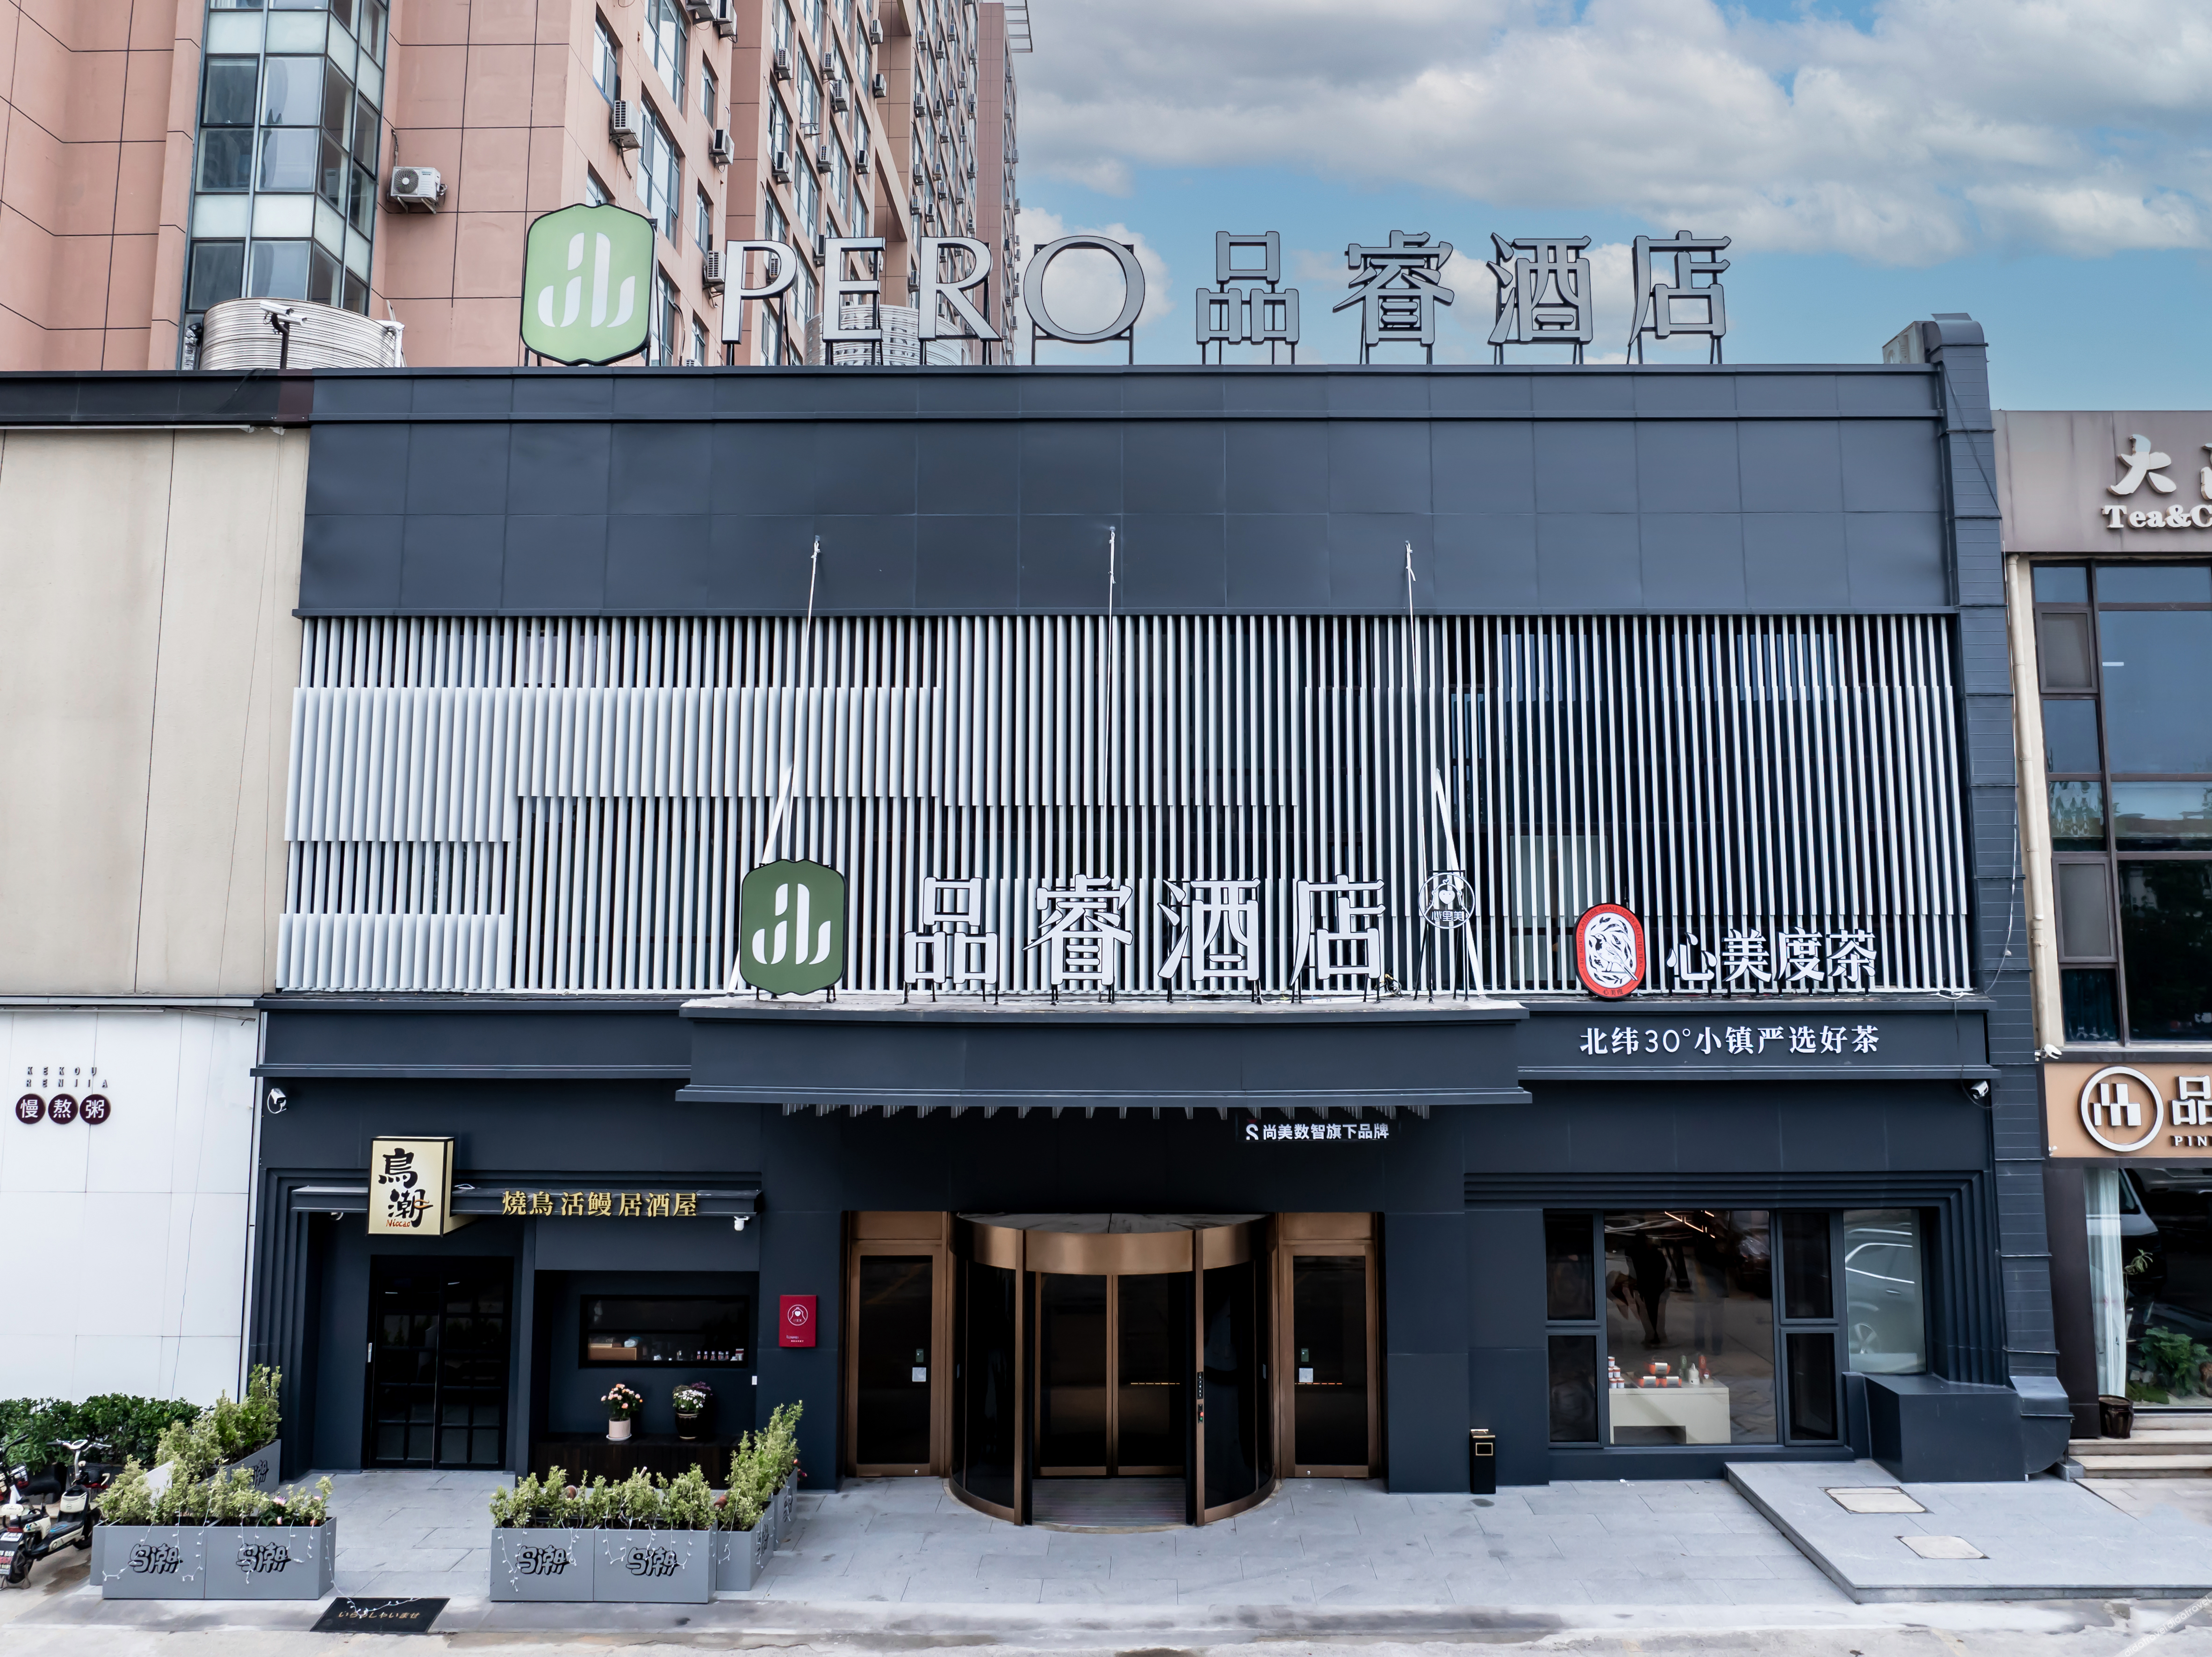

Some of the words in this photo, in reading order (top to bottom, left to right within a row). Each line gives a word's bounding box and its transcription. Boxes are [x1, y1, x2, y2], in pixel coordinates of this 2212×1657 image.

[722, 235, 1145, 344] PERO
[1196, 230, 1731, 347] 品睿酒店
[2107, 434, 2212, 500] 大
[905, 874, 1385, 985] 品睿酒店
[1432, 910, 1463, 921] 心里美
[1579, 909, 1599, 931] LATITUDE
[1621, 909, 1636, 924] TOWN
[1634, 924, 1643, 951] SELECTED
[1666, 926, 1877, 983] 心美度茶
[1579, 1025, 1879, 1055] 北纬30°小镇严选好茶
[26, 1079, 108, 1088] RENJIA
[27, 1066, 97, 1076] KEKOU
[20, 1099, 105, 1119] 慢熬粥
[2170, 1075, 2212, 1126] 品
[1263, 1123, 1389, 1140] 尚美数智旗下品牌
[2173, 1136, 2212, 1147] PIN
